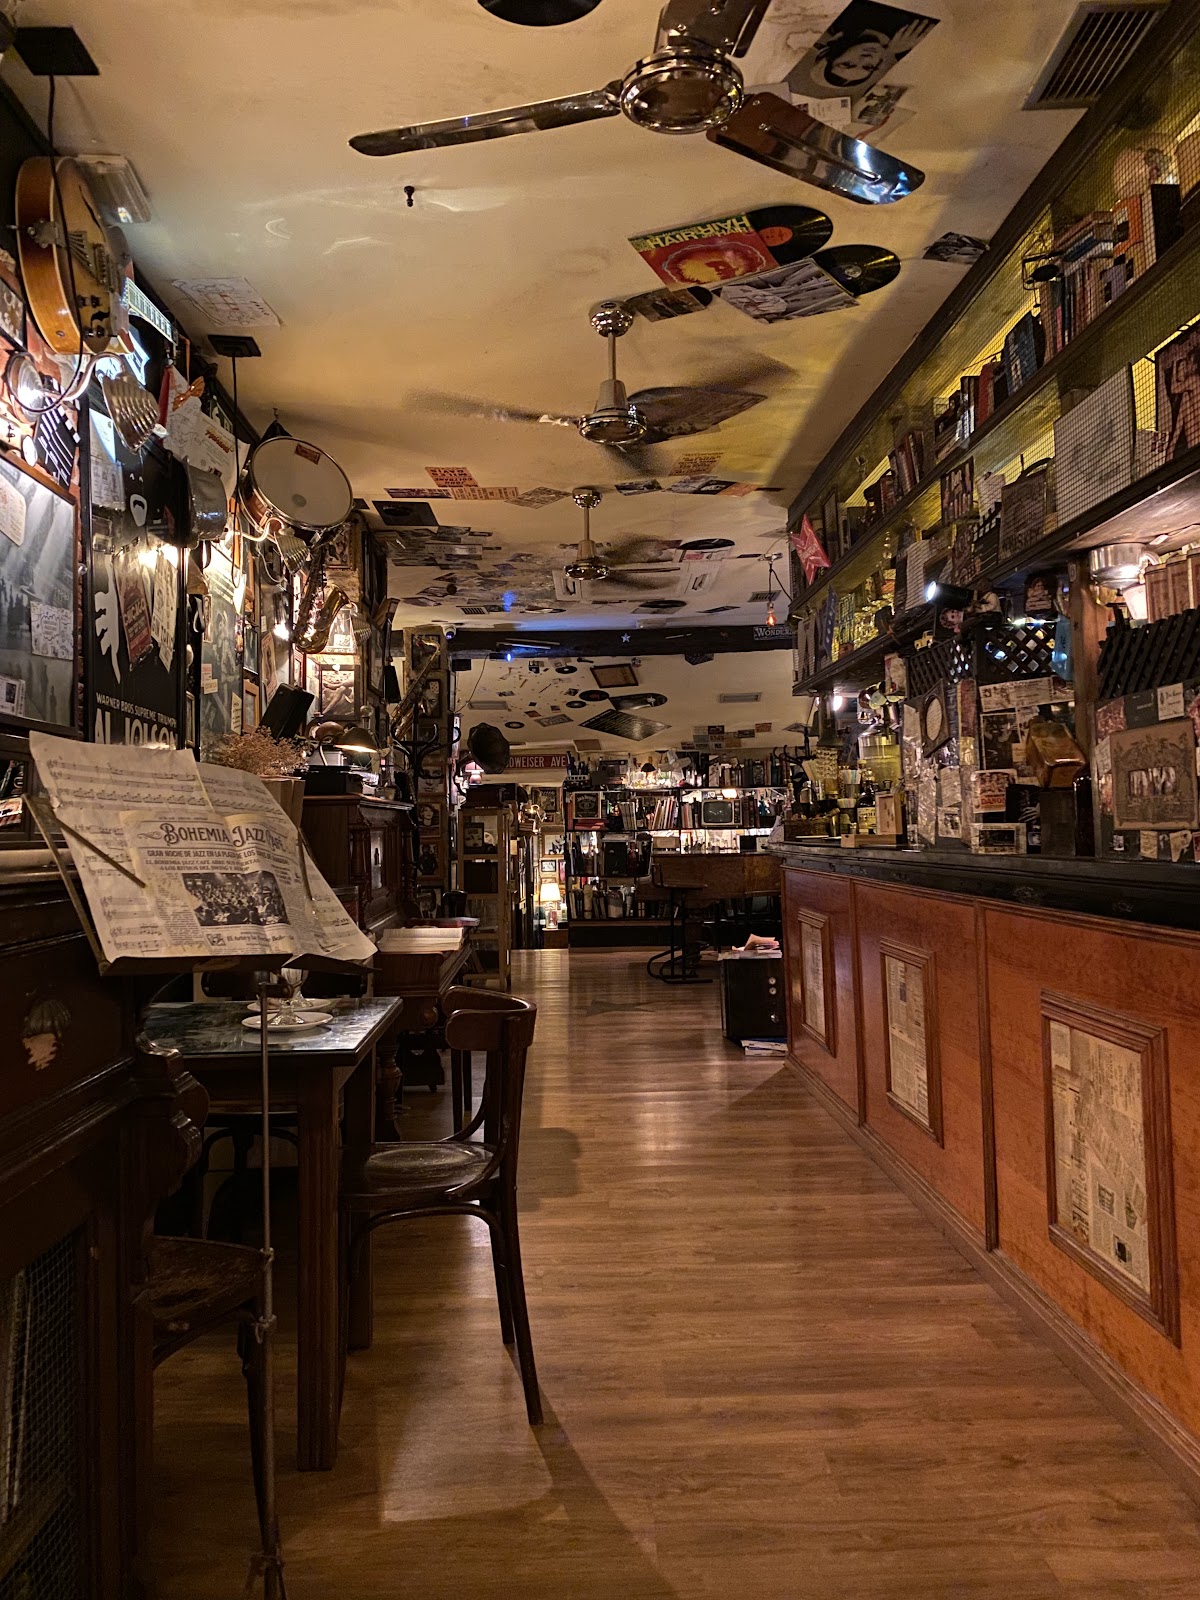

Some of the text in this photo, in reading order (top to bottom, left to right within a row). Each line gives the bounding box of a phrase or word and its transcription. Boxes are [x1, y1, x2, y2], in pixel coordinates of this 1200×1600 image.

[646, 230, 700, 249] HAIR
[96, 692, 120, 709] WARNER
[134, 705, 157, 721] SUPREME
[550, 756, 566, 767] AVE
[160, 823, 230, 846] BOHEMIA
[231, 825, 266, 848] JAZZ
[243, 850, 256, 858] LOS
